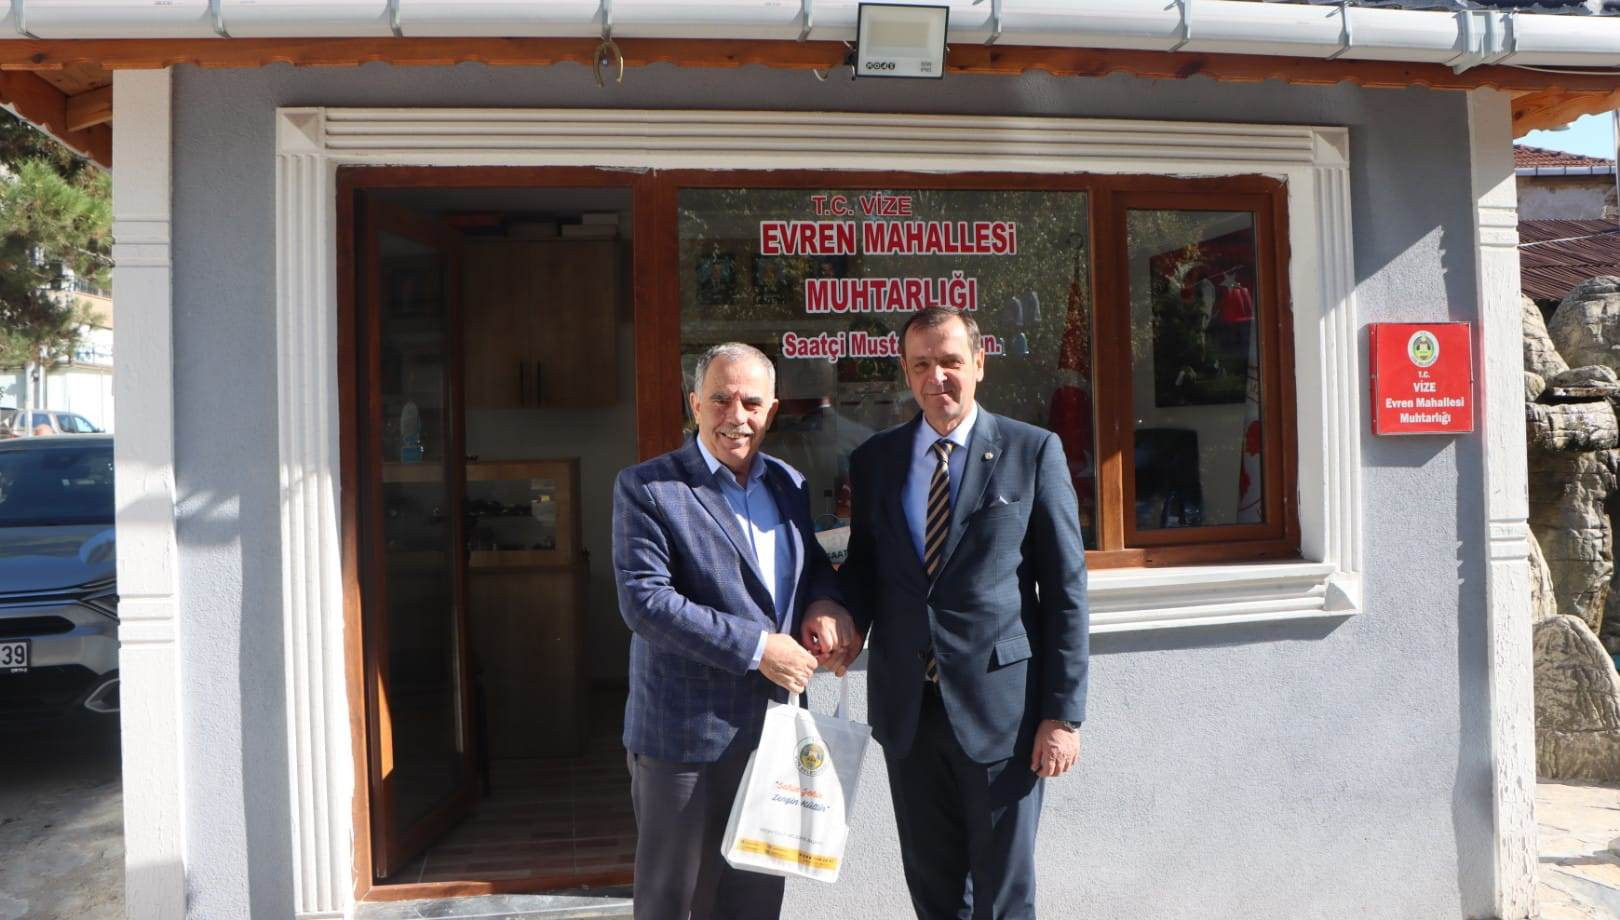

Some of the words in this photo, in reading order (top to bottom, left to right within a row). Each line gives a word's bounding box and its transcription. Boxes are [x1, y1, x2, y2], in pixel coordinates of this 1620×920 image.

[810, 195, 855, 217] T.C.
[859, 191, 913, 217] VİZE
[760, 221, 857, 256] EVREN
[805, 270, 977, 314] MUHTARLIĞI
[782, 331, 846, 362] Saatçi
[850, 331, 902, 357] Must
[1385, 398, 1414, 409] Evren
[1416, 397, 1465, 408] Mahallesi
[2, 645, 25, 665] 39
